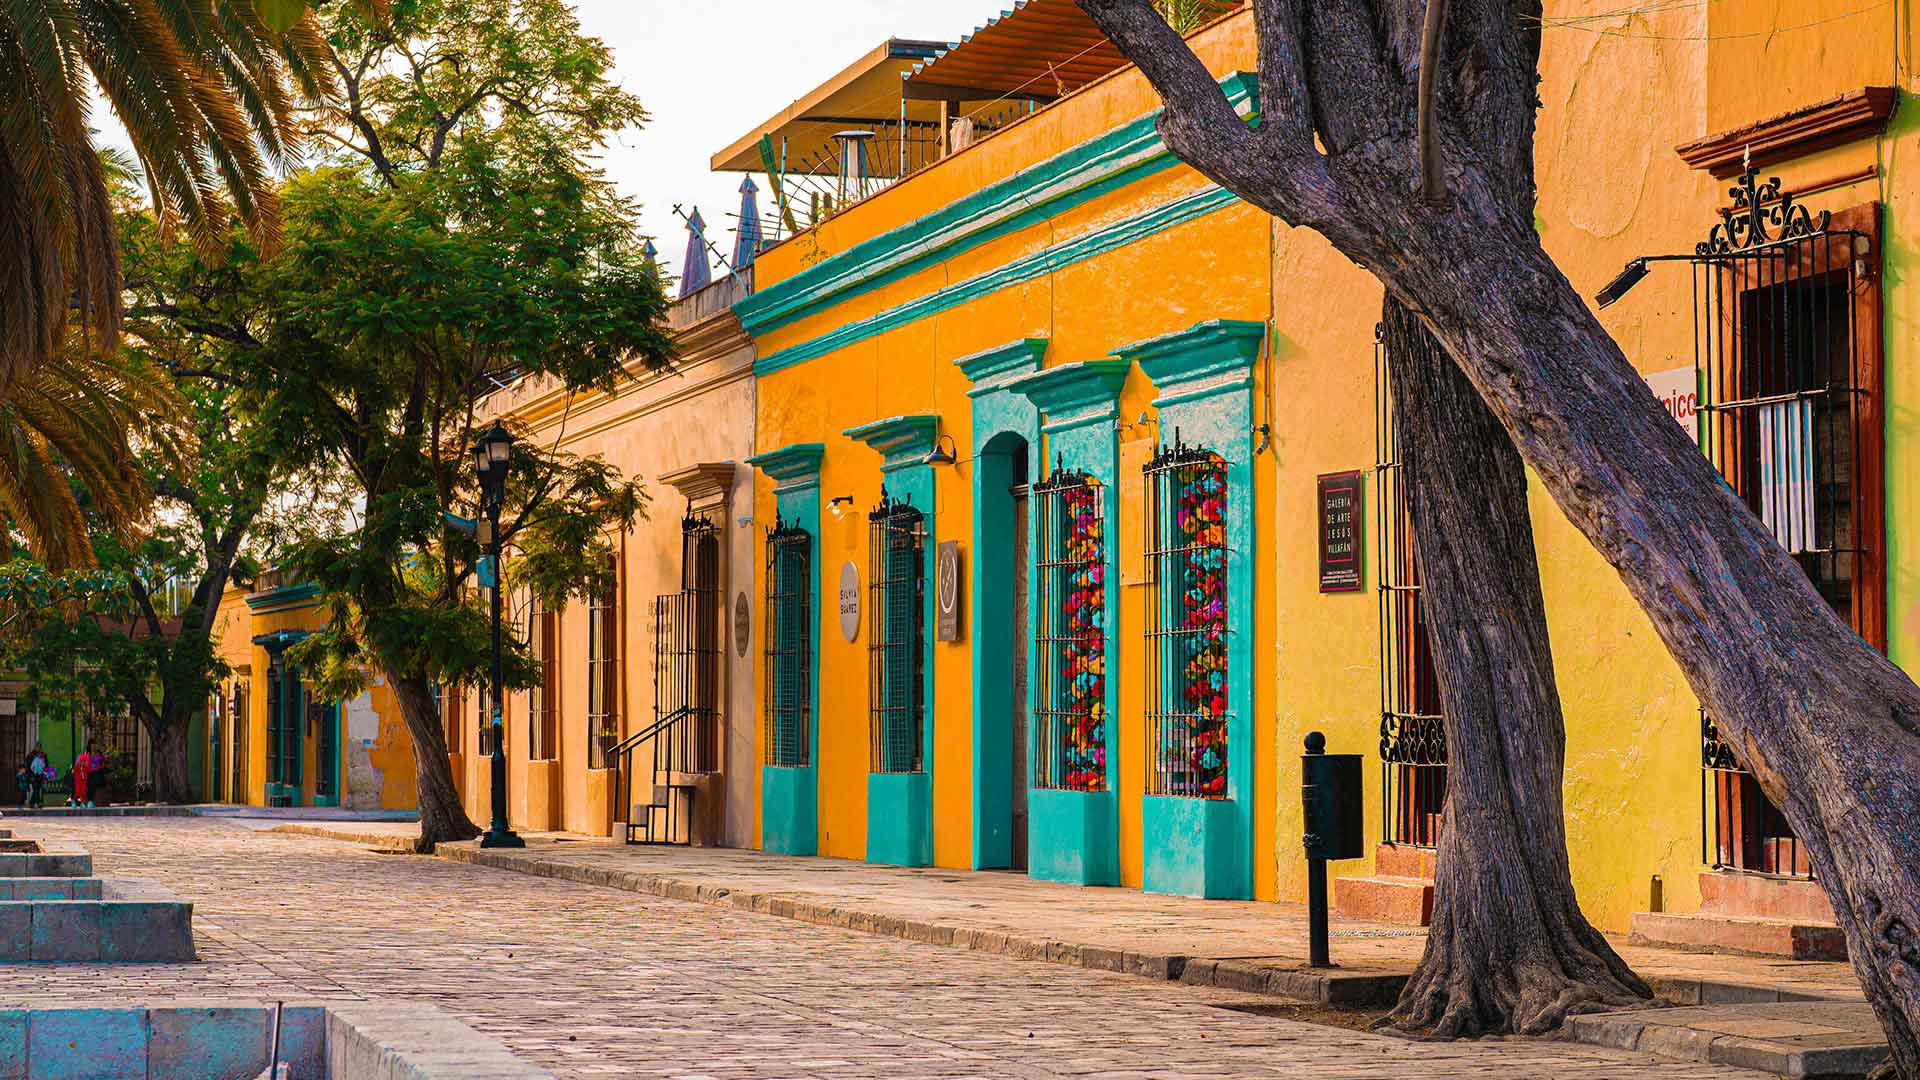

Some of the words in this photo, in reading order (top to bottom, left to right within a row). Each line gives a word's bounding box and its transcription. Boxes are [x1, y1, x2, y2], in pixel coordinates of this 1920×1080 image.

[1656, 388, 1697, 418] nico
[1327, 513, 1335, 524] DE
[1337, 512, 1351, 523] ARTE
